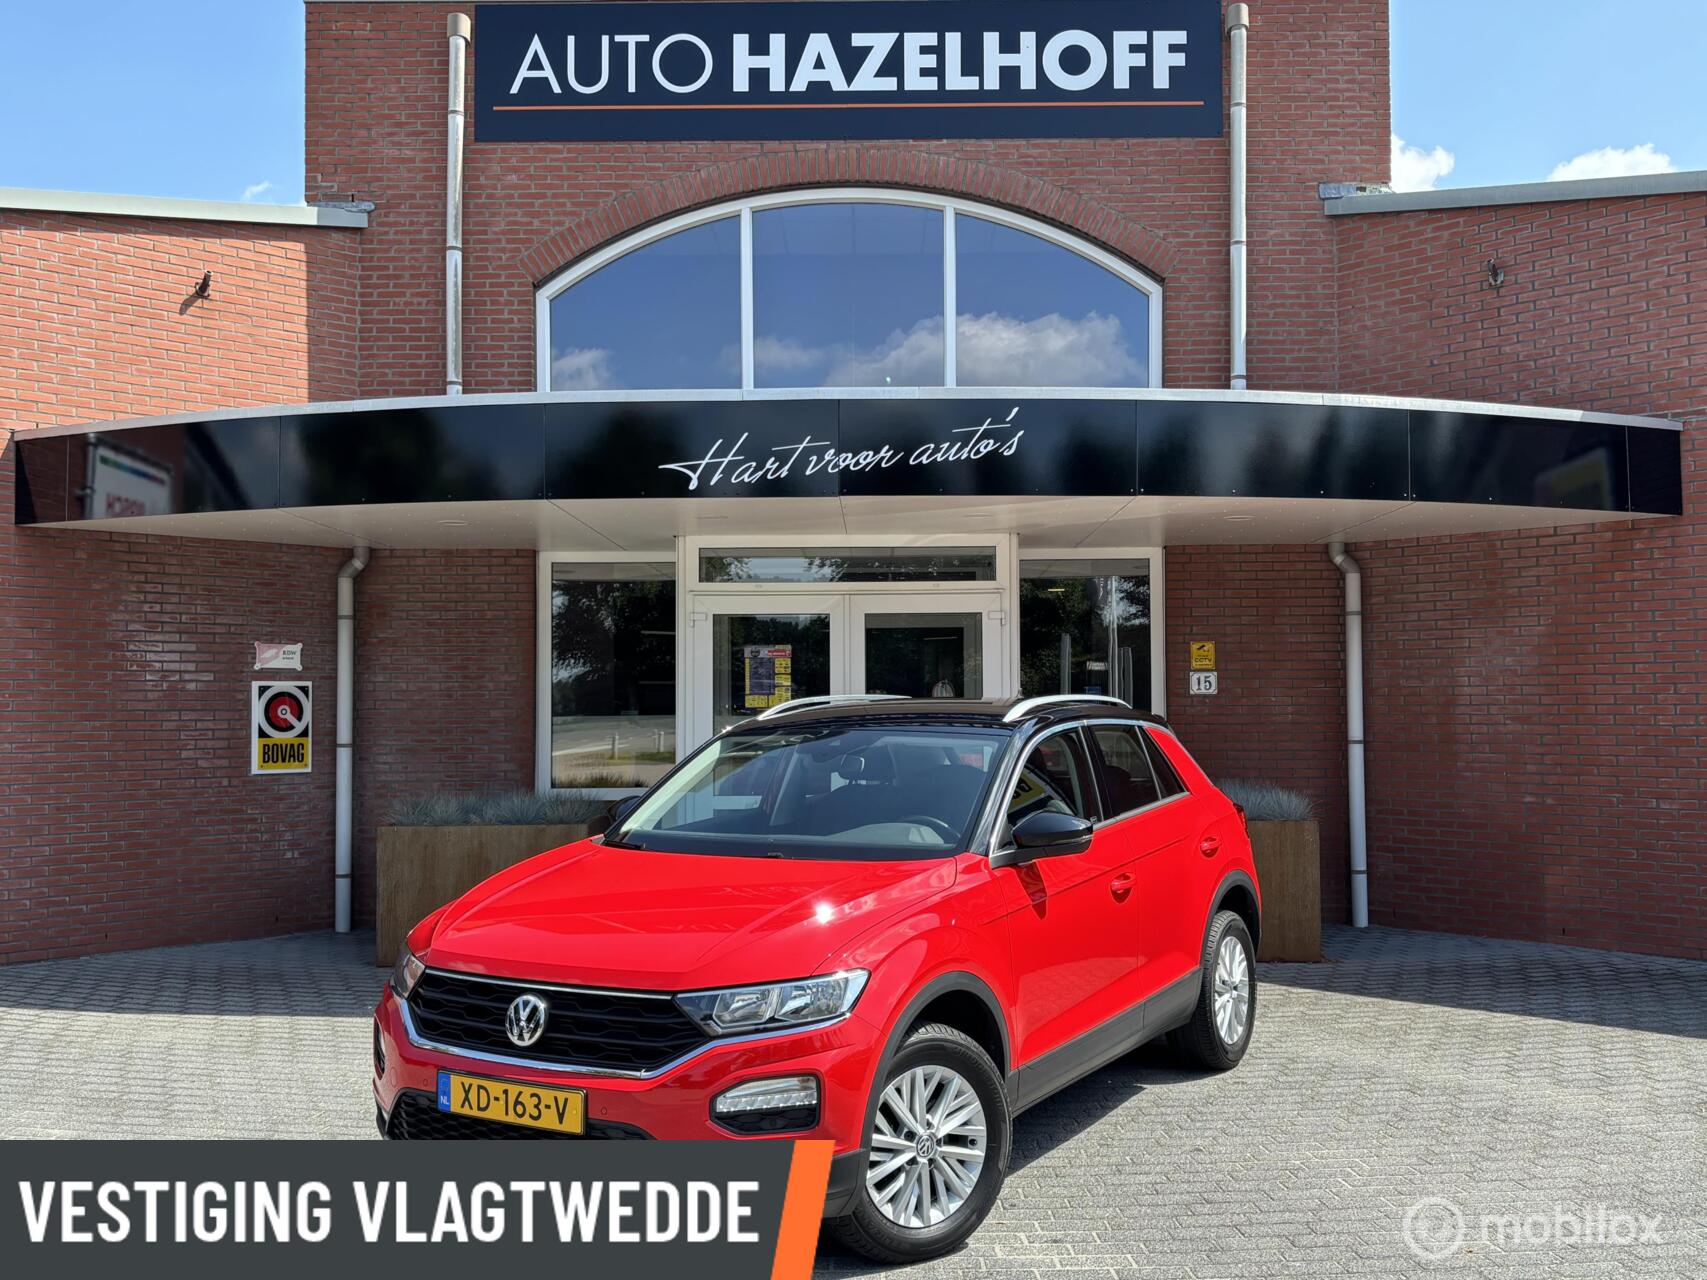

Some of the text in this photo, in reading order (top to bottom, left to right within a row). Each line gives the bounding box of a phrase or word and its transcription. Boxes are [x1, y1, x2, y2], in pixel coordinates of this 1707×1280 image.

[509, 29, 1188, 94] AUTO HAZELHOFF
[658, 407, 1025, 490] Hart voor auto's
[1196, 675, 1212, 691] 15
[262, 743, 305, 764] BOVAG
[440, 1095, 450, 1105] NL
[460, 1081, 569, 1125] XD-163-V
